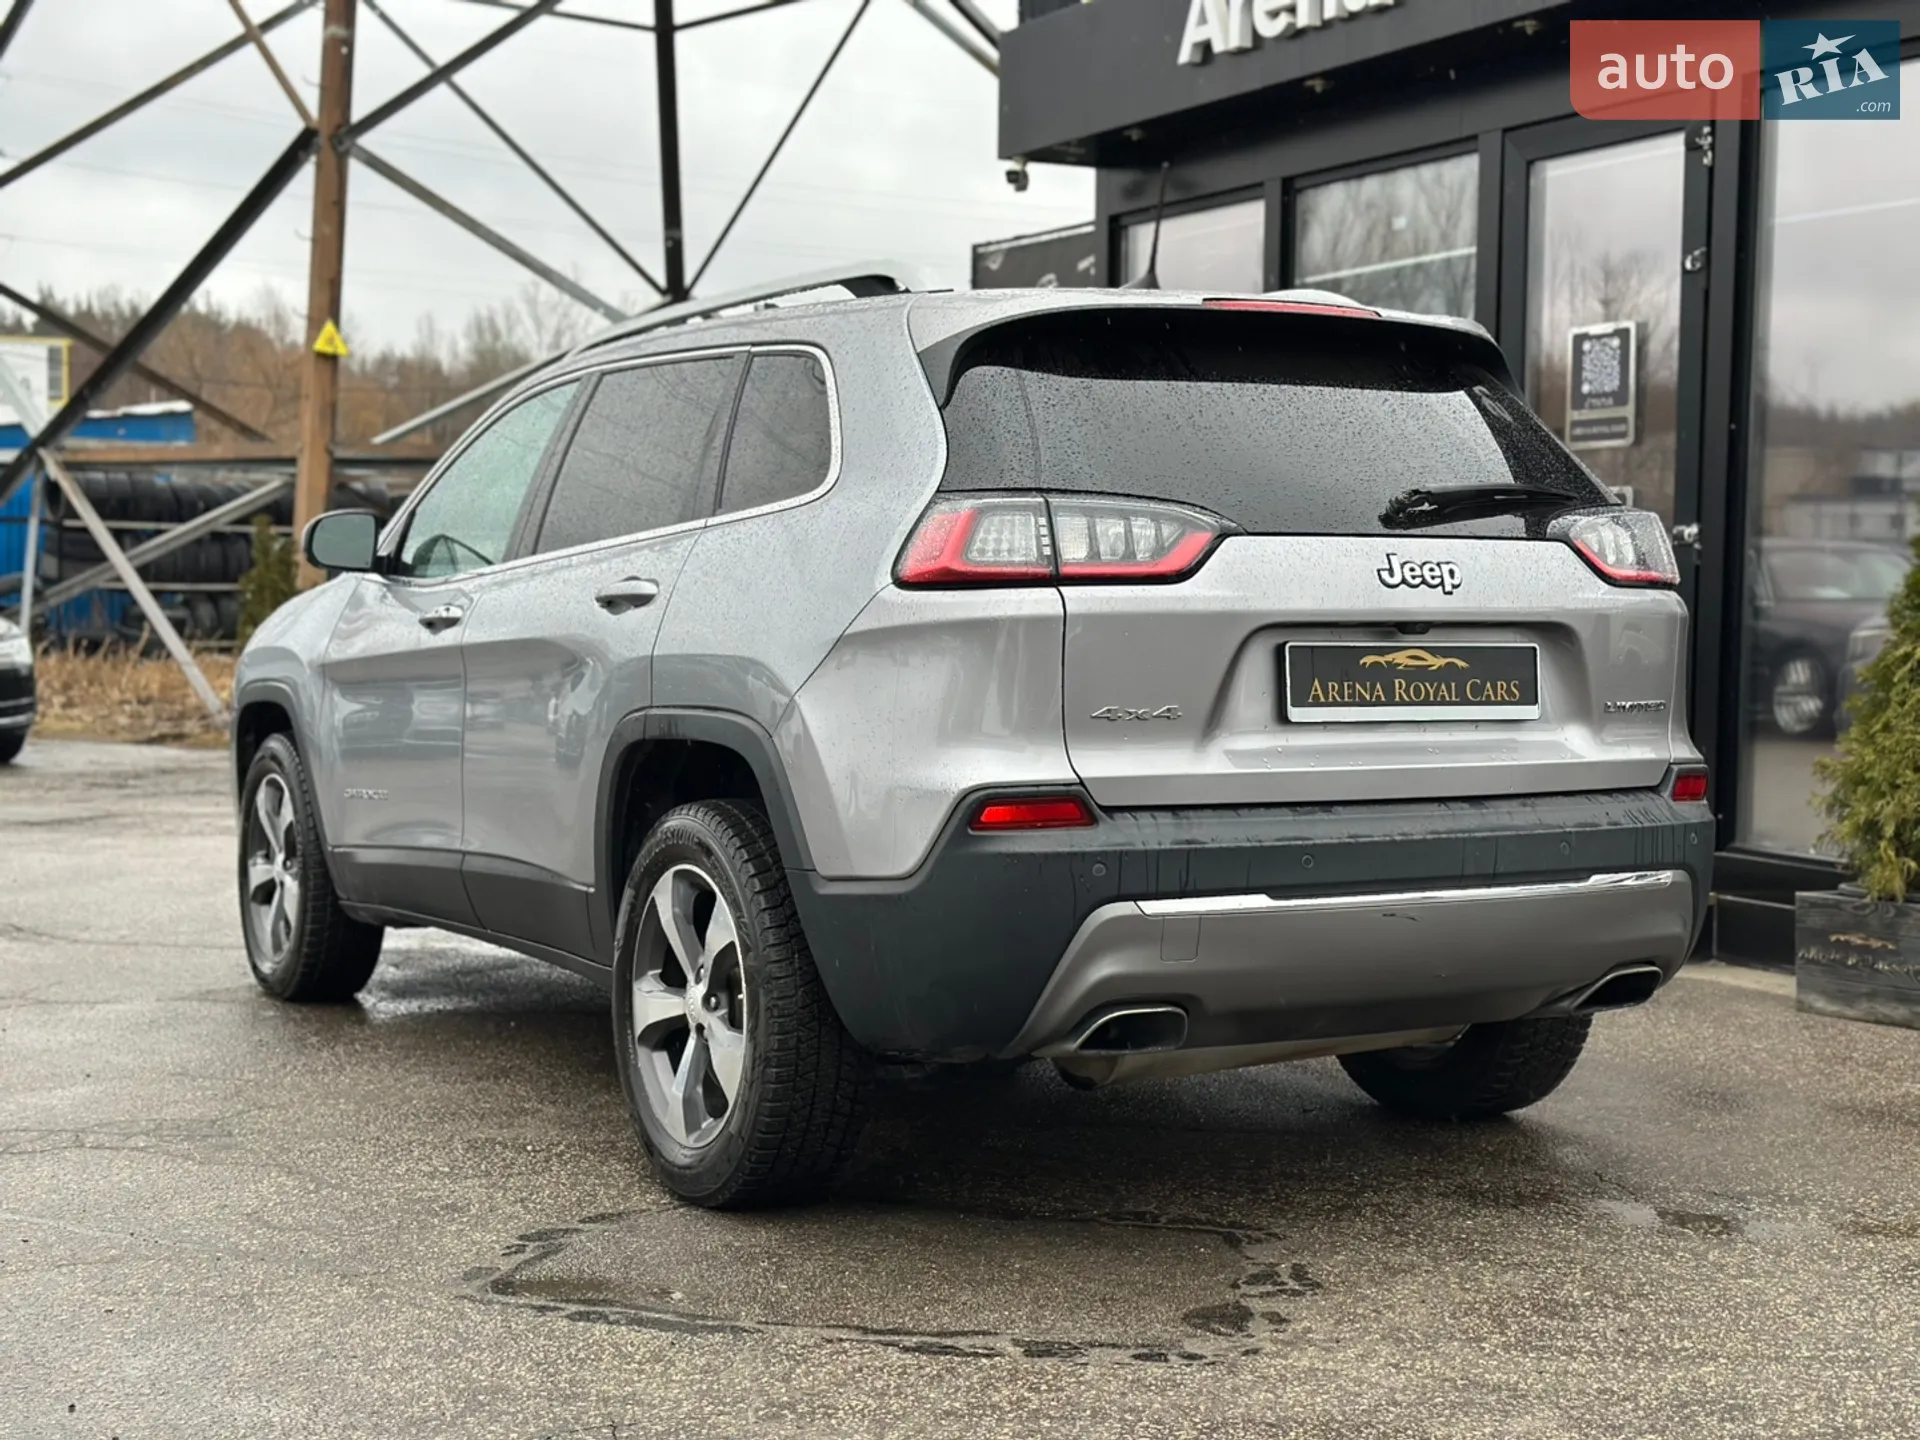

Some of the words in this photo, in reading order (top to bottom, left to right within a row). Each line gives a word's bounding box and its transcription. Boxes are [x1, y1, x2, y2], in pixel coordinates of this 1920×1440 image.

[1177, 0, 1394, 65] Are
[1377, 553, 1462, 595] Jeep
[1308, 677, 1386, 702] ARENA
[1394, 679, 1460, 702] ROYAL
[1466, 679, 1520, 702] CARS
